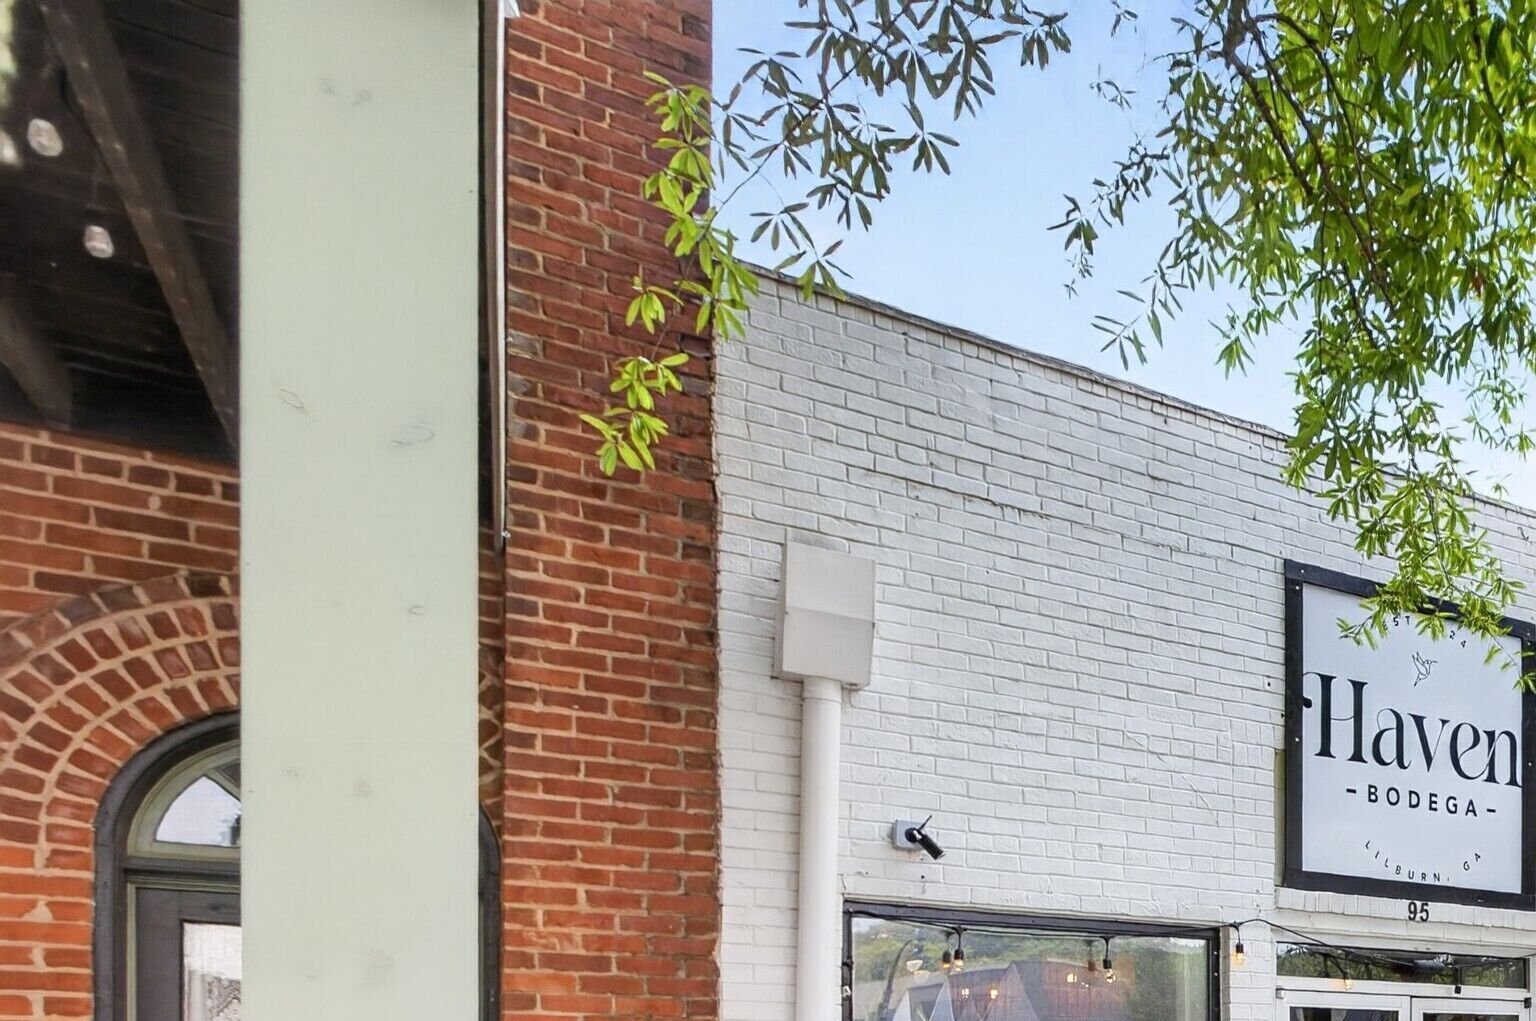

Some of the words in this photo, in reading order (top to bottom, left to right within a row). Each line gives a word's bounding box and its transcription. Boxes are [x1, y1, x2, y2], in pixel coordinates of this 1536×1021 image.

[1302, 671, 1522, 788] Haven
[1367, 784, 1478, 818] BODEGA
[1462, 852, 1482, 871] GA
[1407, 901, 1430, 922] 95
